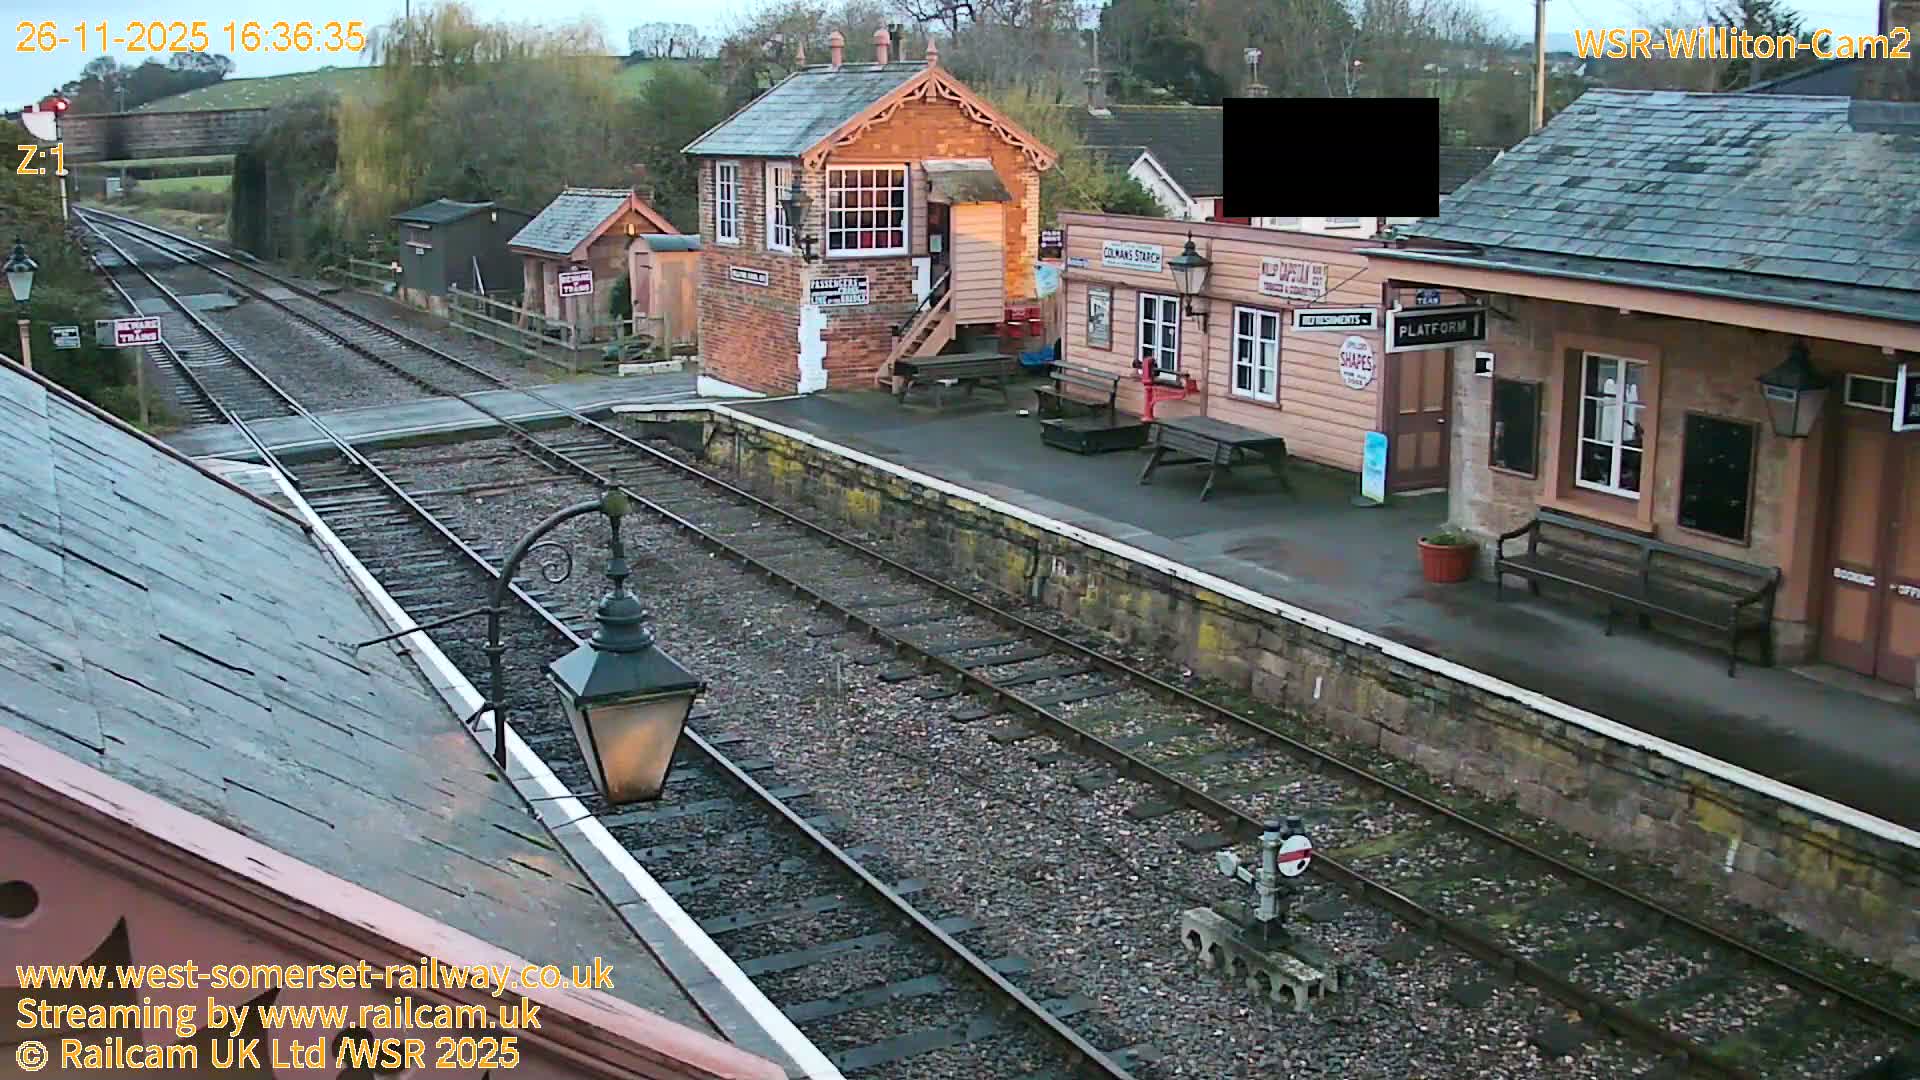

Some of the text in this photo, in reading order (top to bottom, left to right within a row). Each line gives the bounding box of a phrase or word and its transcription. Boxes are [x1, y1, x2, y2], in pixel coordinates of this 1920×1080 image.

[1134, 249, 1160, 264] STARCH
[1399, 319, 1467, 339] PLATFORM
[1341, 351, 1371, 371] SHAPES
